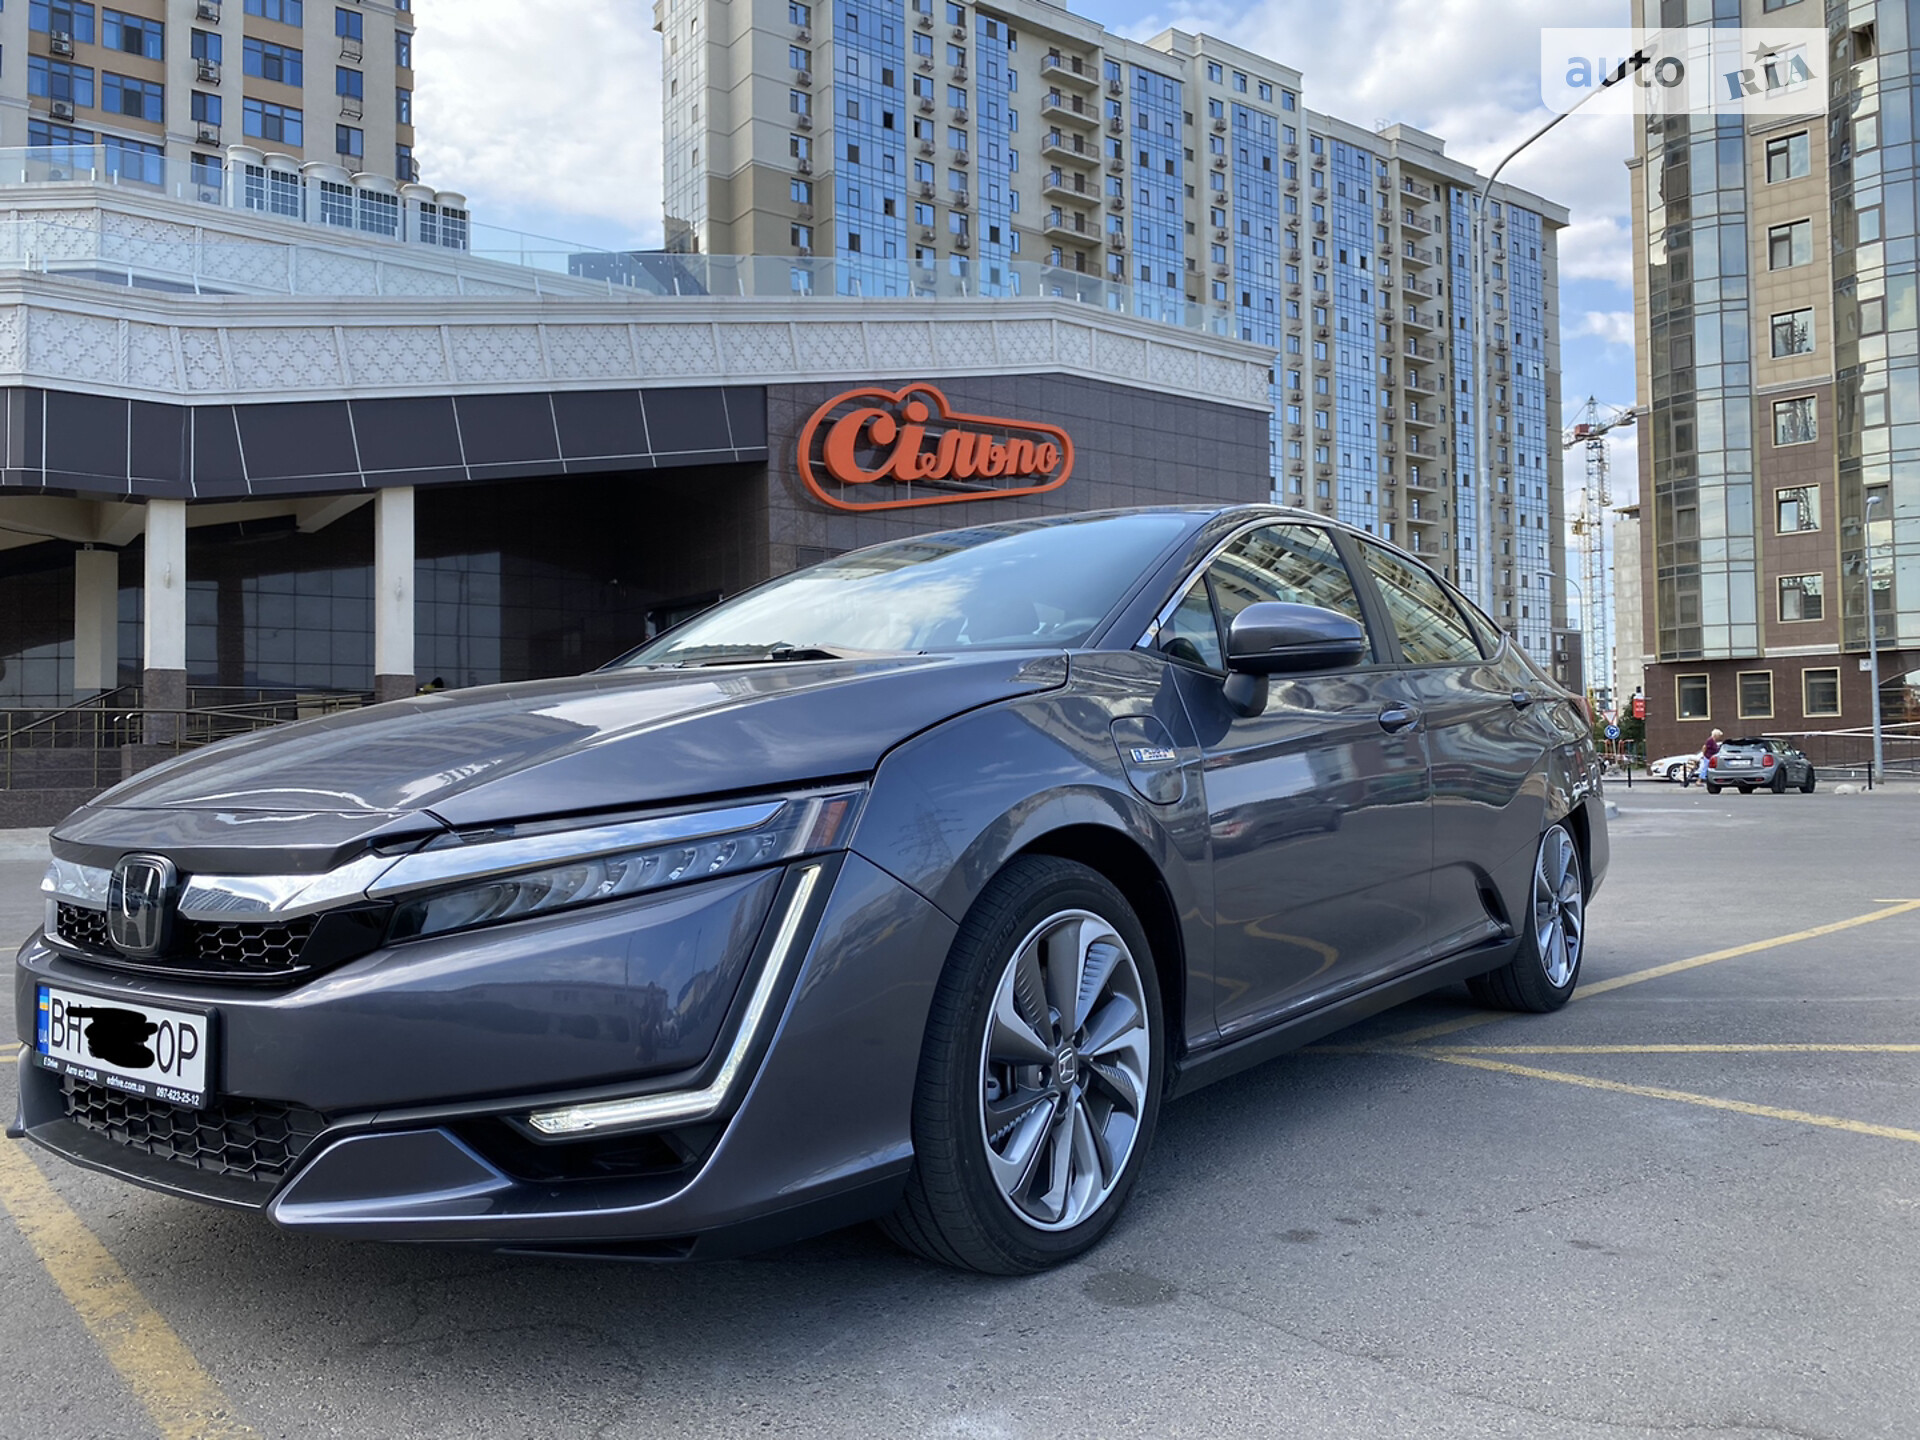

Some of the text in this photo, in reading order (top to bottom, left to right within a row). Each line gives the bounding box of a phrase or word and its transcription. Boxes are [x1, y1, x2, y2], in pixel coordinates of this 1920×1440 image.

[823, 401, 1060, 484] Сільпо
[38, 1029, 48, 1044] UA
[156, 1020, 198, 1076] OP
[106, 1075, 146, 1093] edrive.com.ua
[156, 1086, 200, 1106] 097-623-25-12
